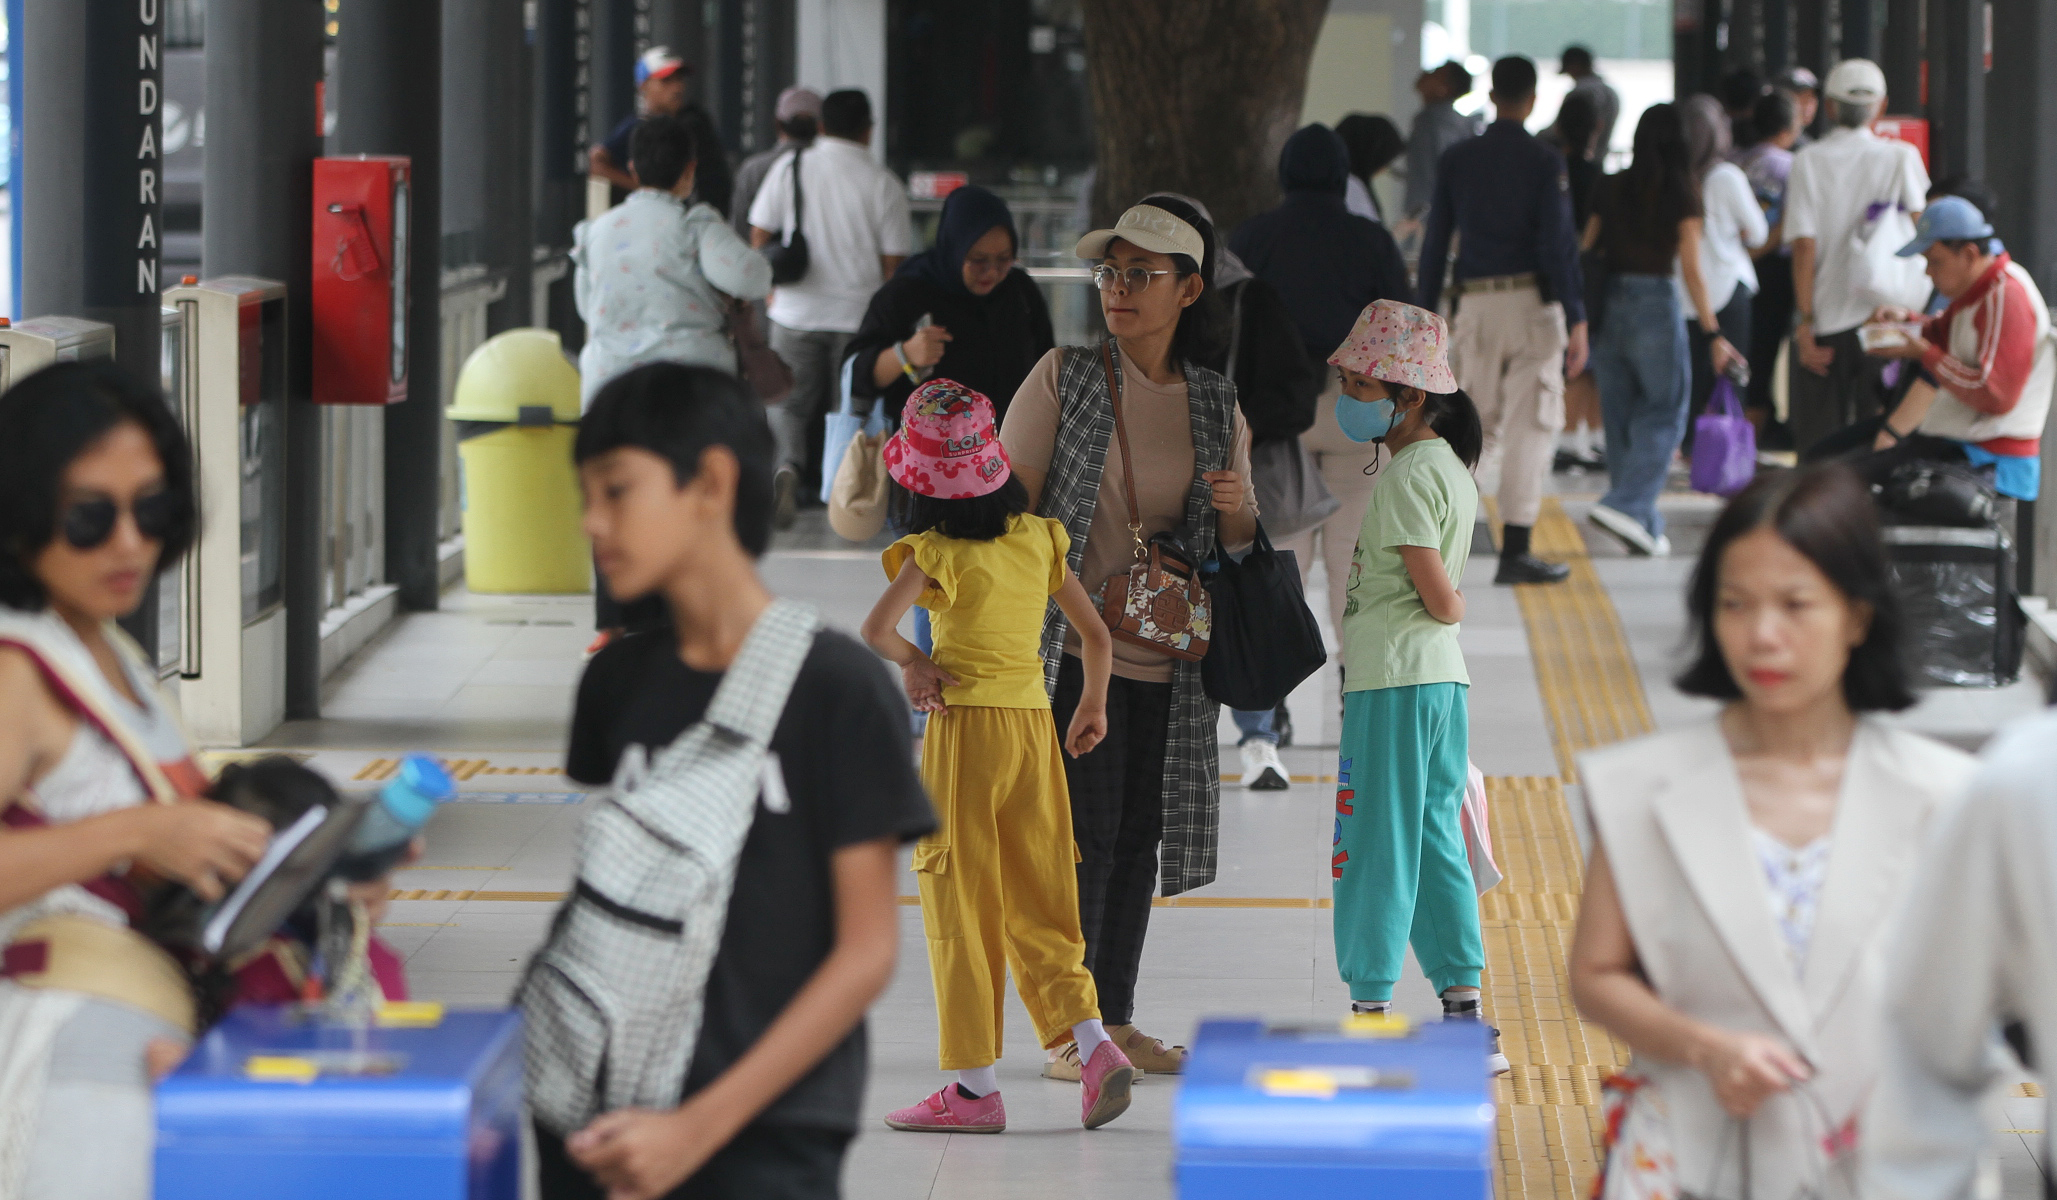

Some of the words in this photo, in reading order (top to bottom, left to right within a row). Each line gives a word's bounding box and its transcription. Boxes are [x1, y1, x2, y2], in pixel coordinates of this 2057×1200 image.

[138, 0, 157, 294] UNDARAN
[947, 432, 986, 452] LOL
[982, 456, 1003, 476] LOL
